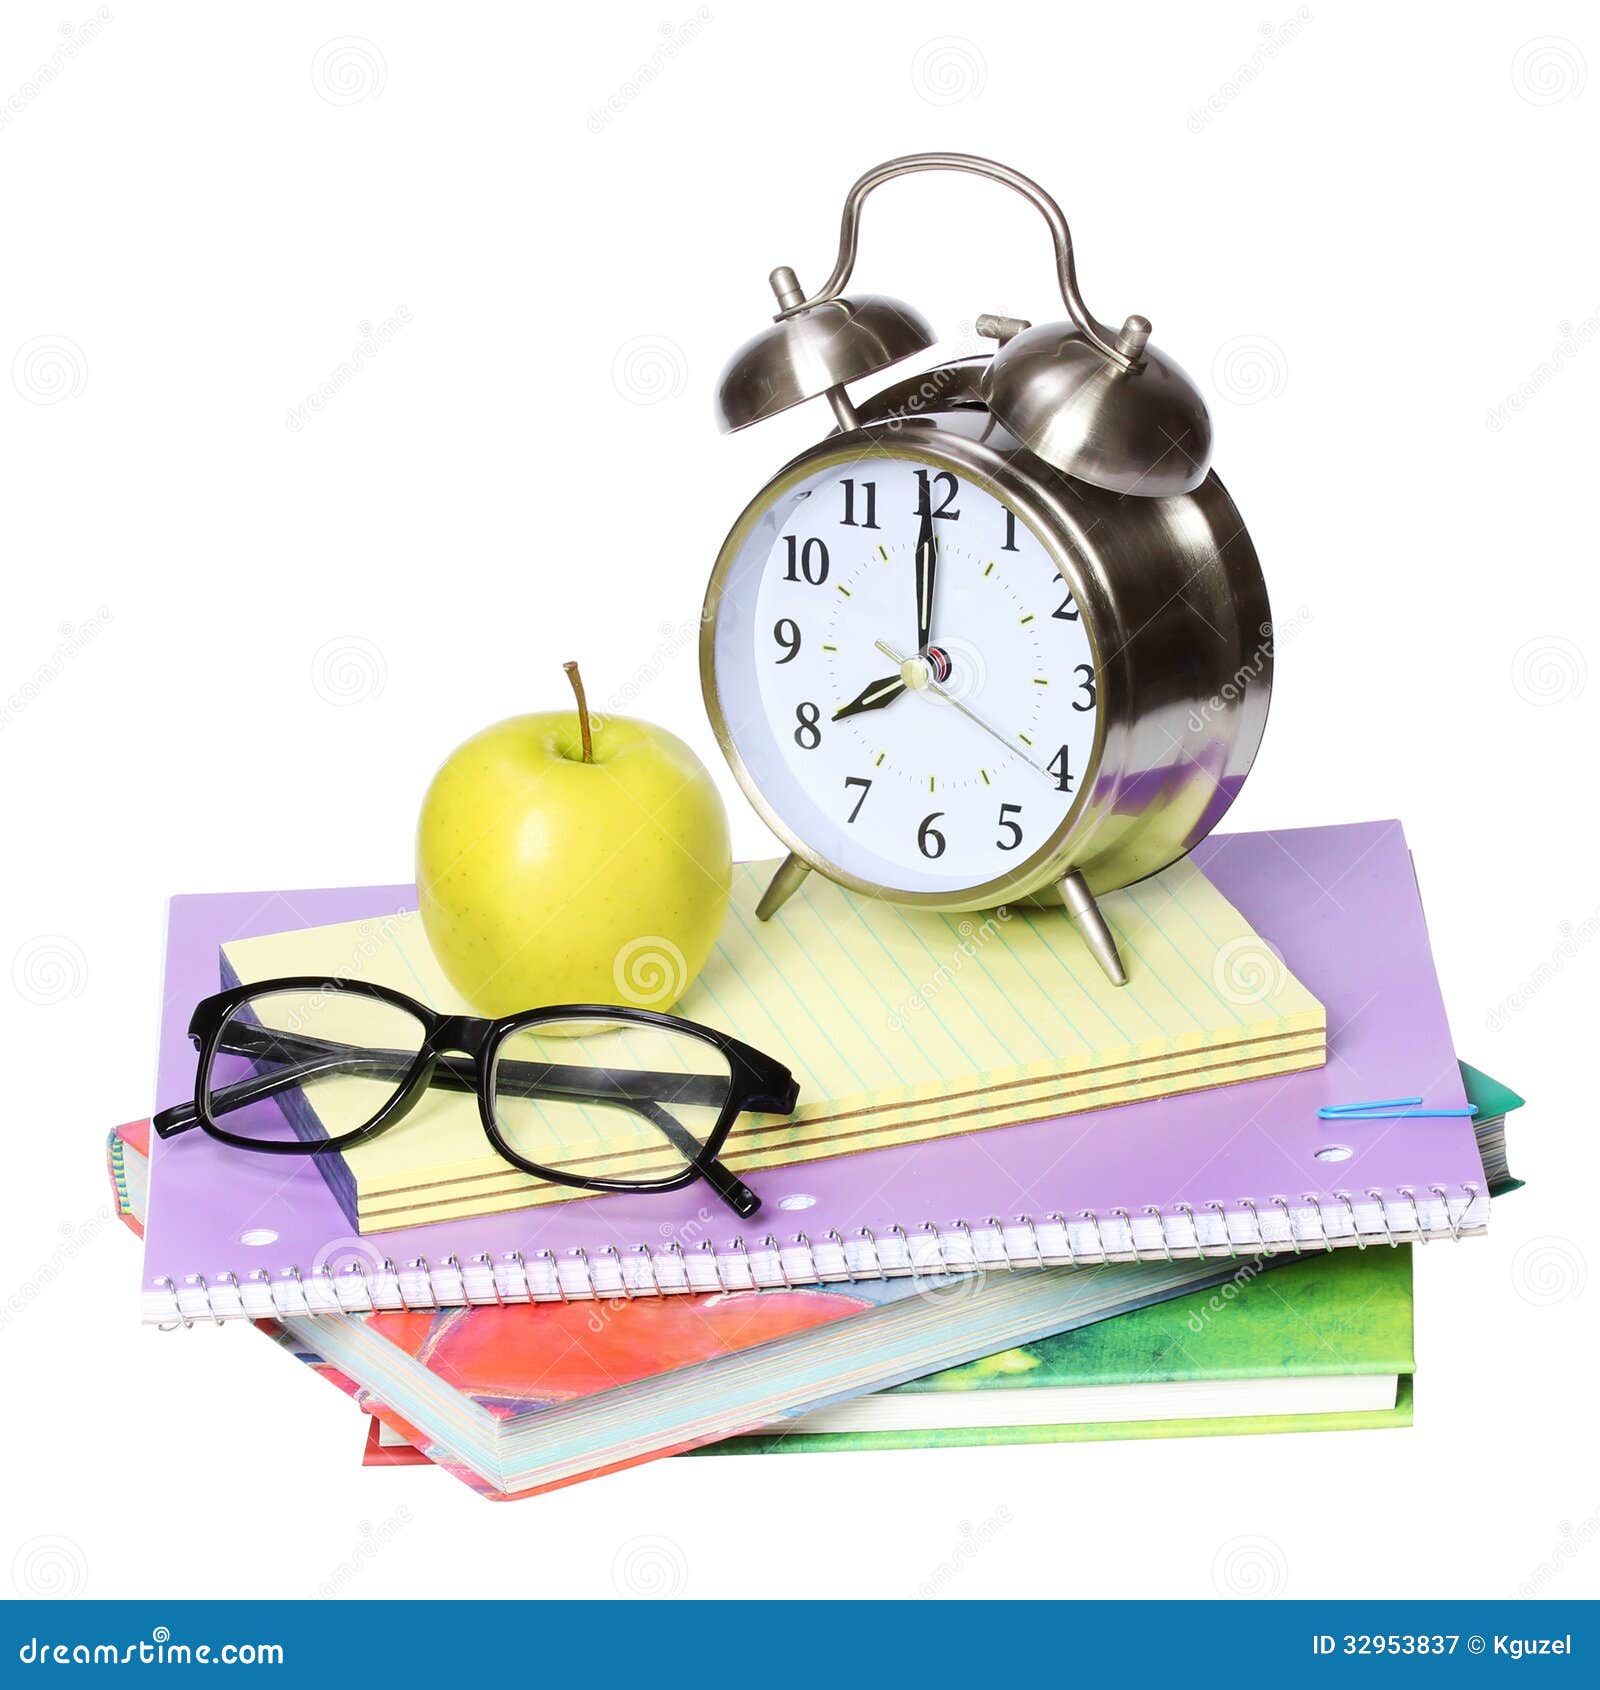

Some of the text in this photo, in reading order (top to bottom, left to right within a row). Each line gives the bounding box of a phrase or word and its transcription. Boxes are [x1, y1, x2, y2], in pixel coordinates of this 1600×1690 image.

[839, 478, 881, 529] 11
[913, 470, 961, 520] 12
[1000, 505, 1020, 551] 1
[782, 535, 830, 585] 10
[1051, 573, 1081, 621] 2
[773, 618, 801, 664] 9
[1071, 664, 1097, 712] 3
[794, 702, 821, 749] 8
[1047, 744, 1074, 792] 4
[844, 776, 872, 823] 7
[917, 812, 946, 858] 6
[996, 803, 1023, 850] 5
